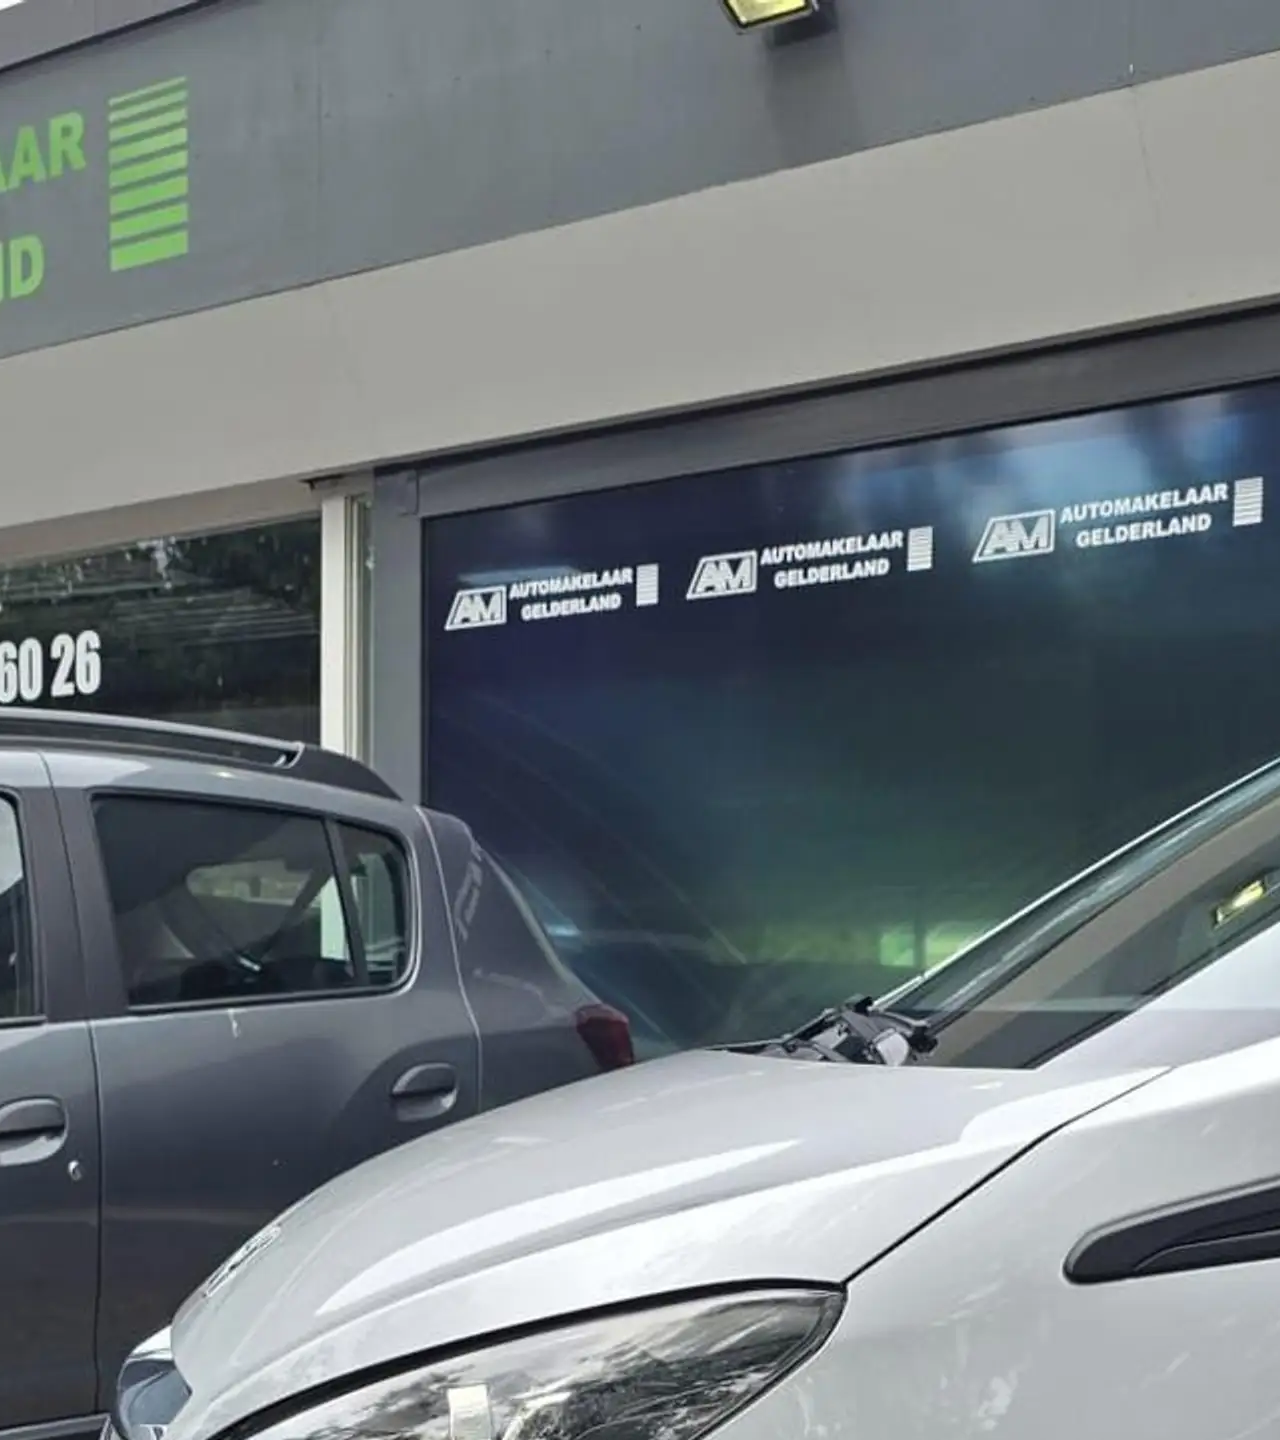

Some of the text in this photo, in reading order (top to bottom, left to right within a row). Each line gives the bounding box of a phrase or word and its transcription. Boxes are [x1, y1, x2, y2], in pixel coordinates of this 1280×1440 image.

[1060, 483, 1229, 524] AUTOMAKELAAR
[761, 530, 903, 565] AUTOMAKELAAR
[1076, 513, 1212, 548] GELDERLAND
[509, 567, 633, 600] AUTOMAKELAAR
[774, 558, 890, 589] GELDERLAND
[521, 594, 622, 621] GELDERLAND
[50, 630, 102, 697] 26
